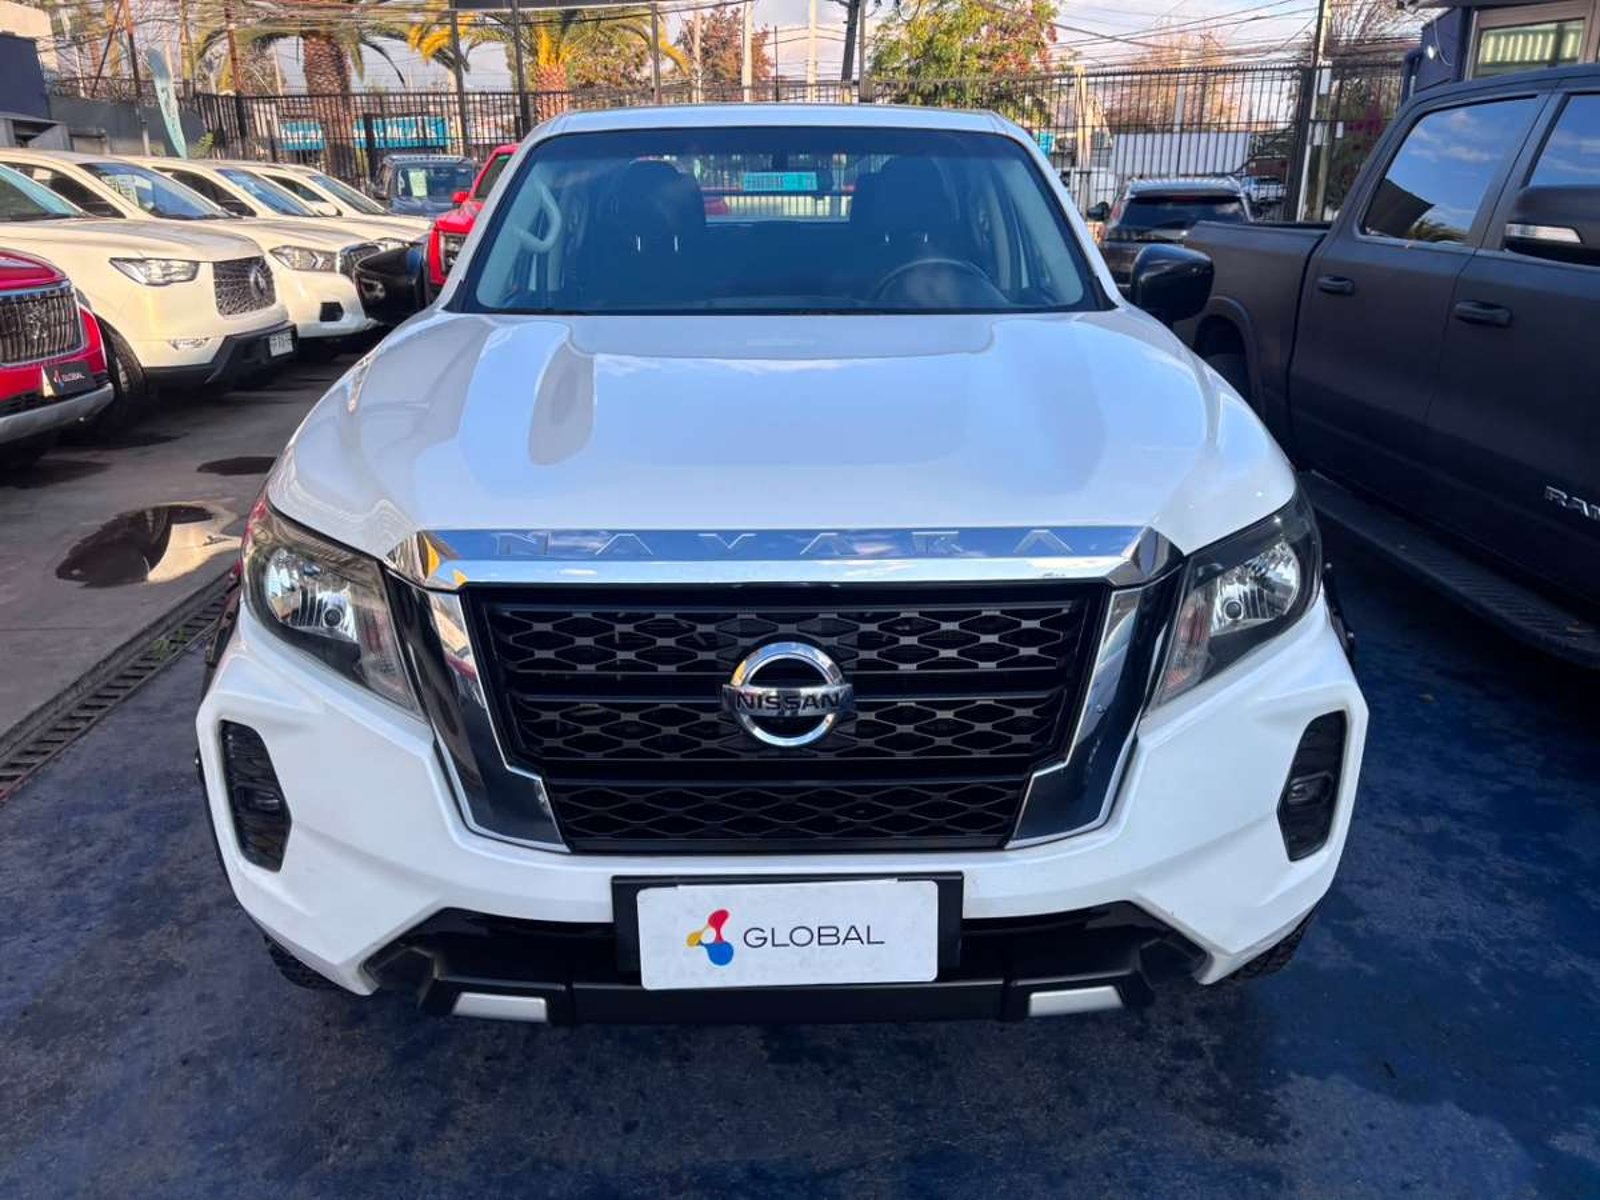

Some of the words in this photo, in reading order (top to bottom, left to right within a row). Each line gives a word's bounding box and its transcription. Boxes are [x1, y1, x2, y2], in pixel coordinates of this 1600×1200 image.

[491, 528, 1077, 557] NAVARA
[736, 692, 840, 711] NISSAN
[743, 924, 886, 949] GLOBAL
